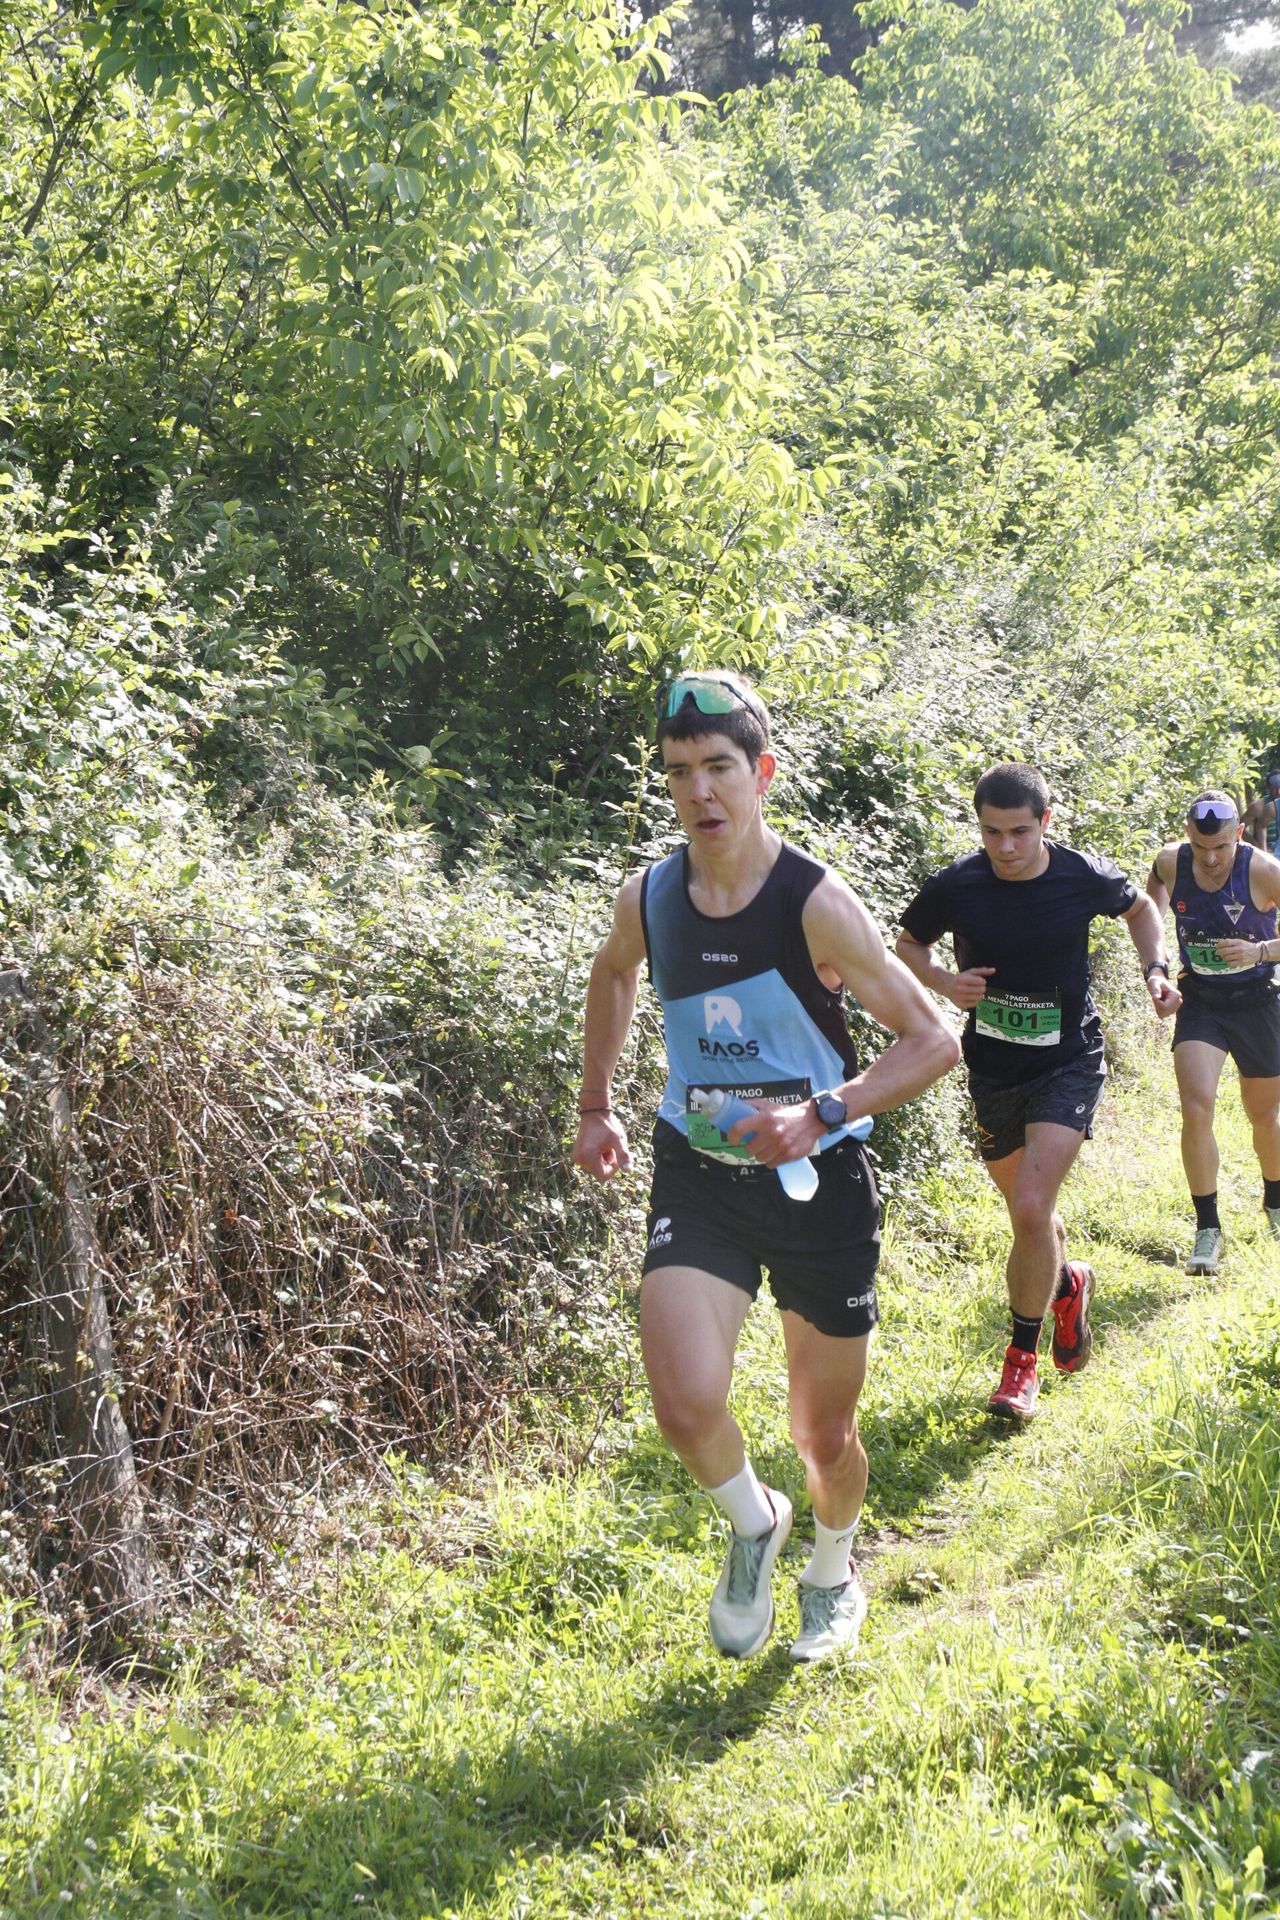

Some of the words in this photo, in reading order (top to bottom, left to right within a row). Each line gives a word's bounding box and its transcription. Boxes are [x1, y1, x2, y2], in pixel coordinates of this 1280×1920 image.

[987, 995, 1009, 1006] MENDI
[1009, 1001, 1055, 1009] LASTERKETA
[1009, 995, 1029, 1003] PAGO
[992, 1007, 1038, 1030] 101
[735, 1088, 763, 1099] PAGO
